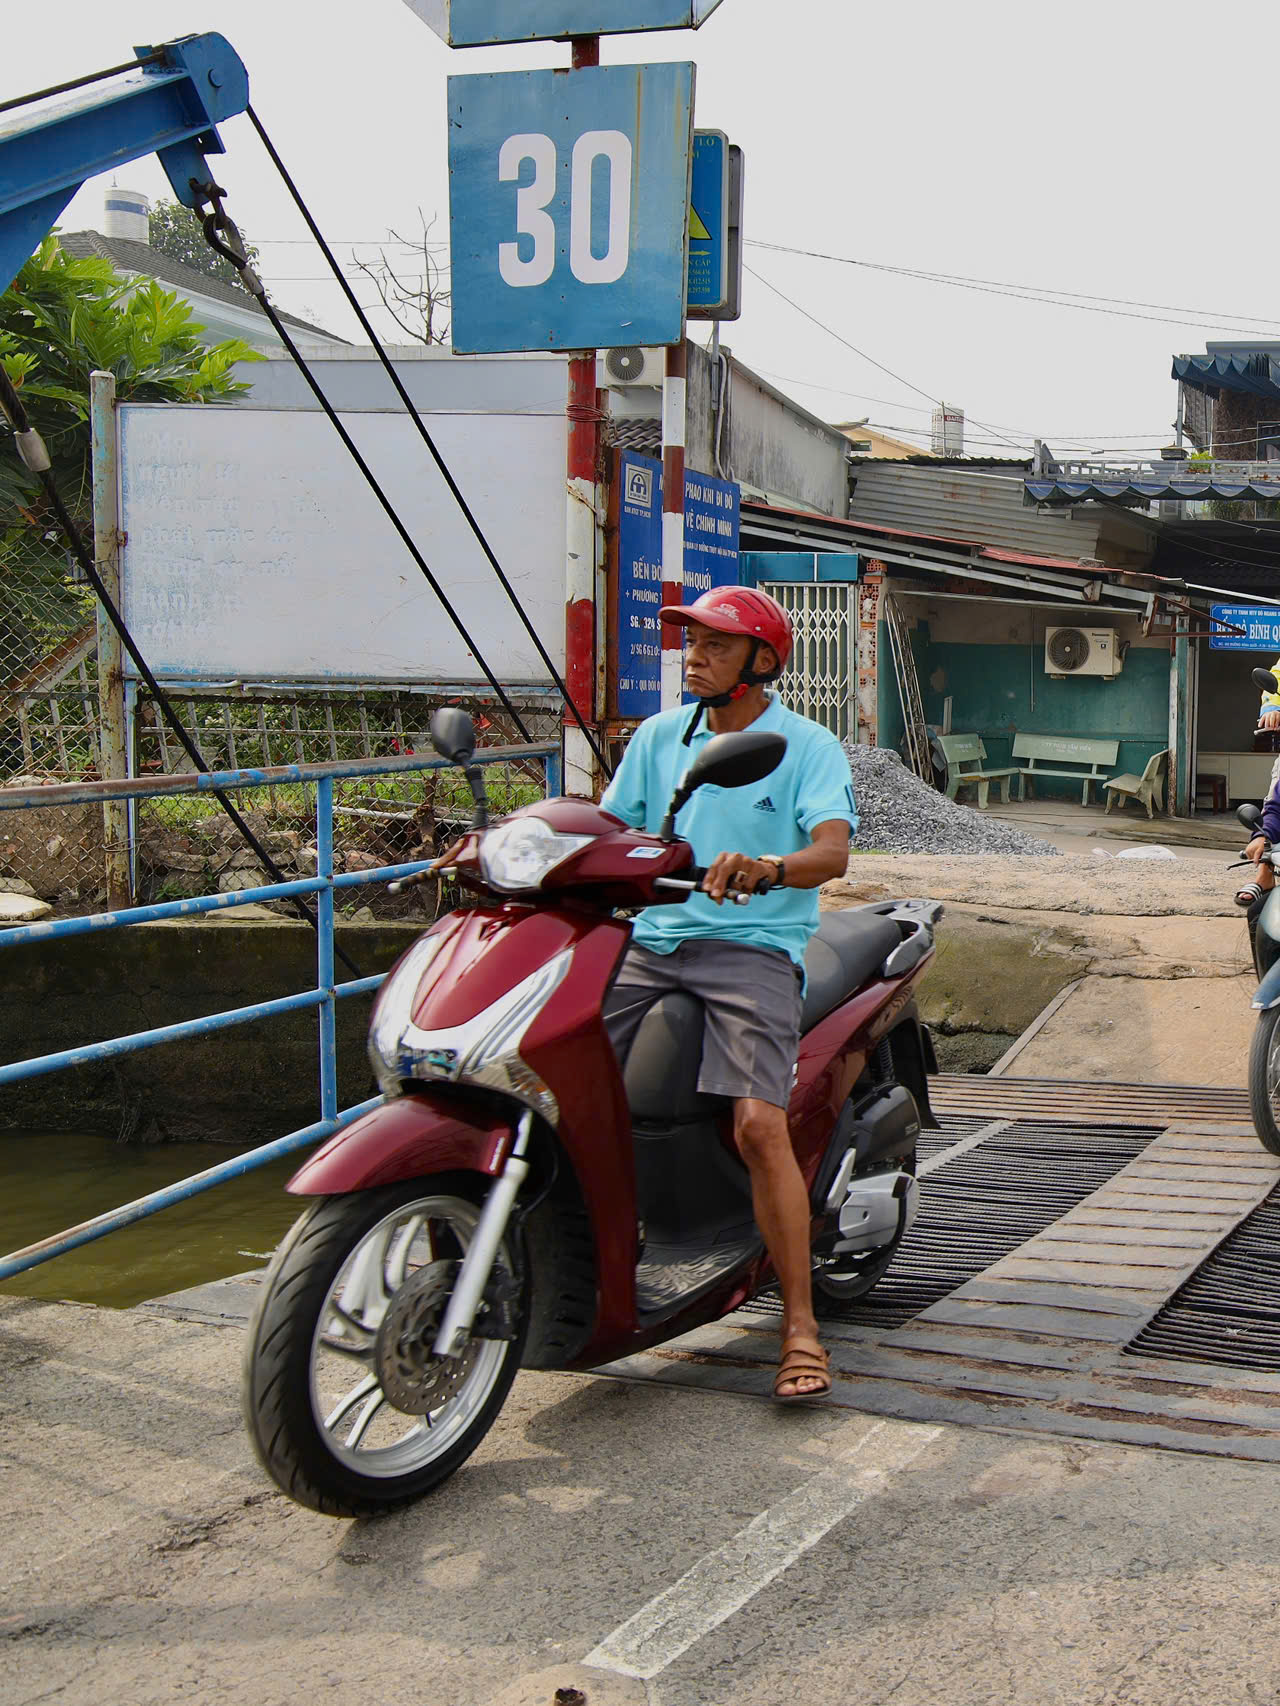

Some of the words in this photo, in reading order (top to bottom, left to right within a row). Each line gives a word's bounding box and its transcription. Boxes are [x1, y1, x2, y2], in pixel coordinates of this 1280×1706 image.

[498, 129, 633, 287] 30
[685, 482, 701, 502] PHAO
[703, 487, 714, 505] KHI
[716, 490, 723, 507] ĐI
[685, 509, 694, 532] VỆ
[695, 512, 716, 534] CHÍNH
[717, 516, 732, 537] MÌNH
[633, 556, 650, 580] BẾN
[652, 559, 662, 582] ĐÒ
[632, 589, 659, 604] PHƯƠNG
[643, 617, 655, 630] 324
[1249, 620, 1270, 640] BÌNH
[620, 674, 630, 690] CHÚ
